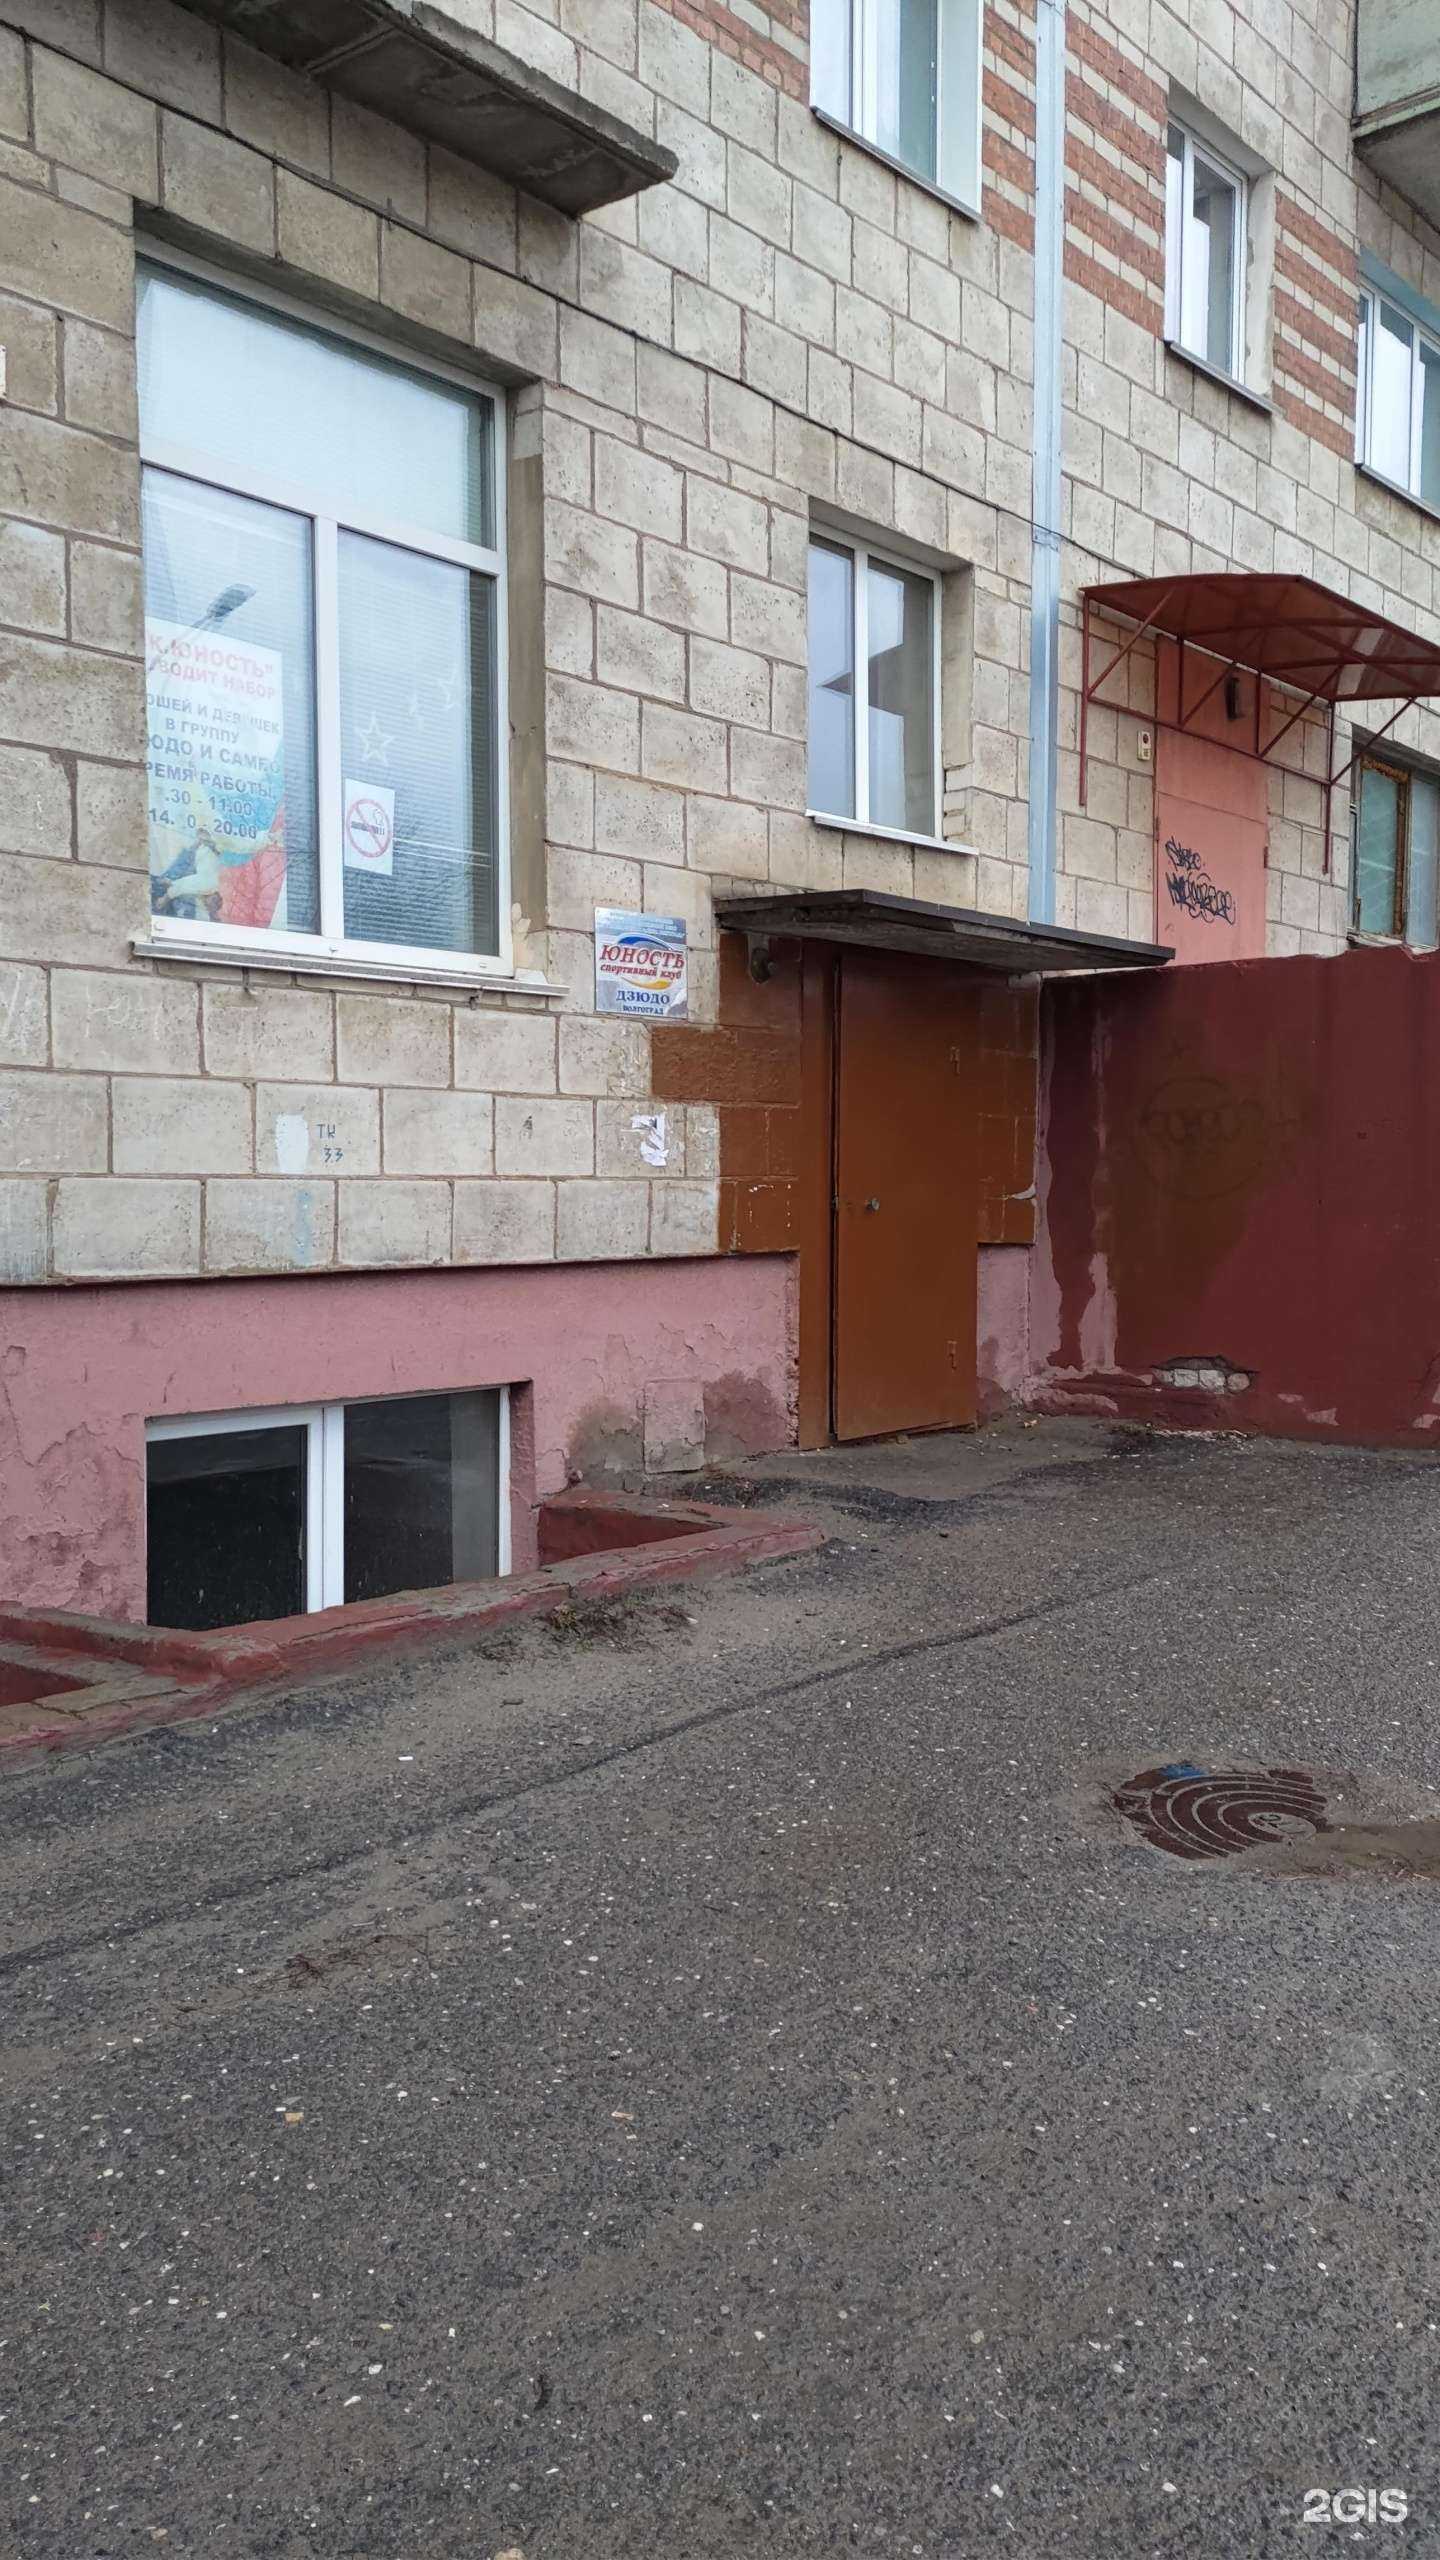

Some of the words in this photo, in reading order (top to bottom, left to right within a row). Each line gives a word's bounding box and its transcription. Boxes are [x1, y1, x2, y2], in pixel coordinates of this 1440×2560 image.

[198, 704, 208, 719] И
[212, 708, 281, 735] ДЕВШЕК
[165, 717, 176, 731] В
[181, 721, 240, 745] ГРУППУ
[200, 744, 212, 761] И
[599, 945, 685, 969] ЮНОСТЬ
[600, 964, 656, 977] спортивный
[660, 971, 681, 980] клуб
[617, 990, 670, 1005] ДЗЮДО
